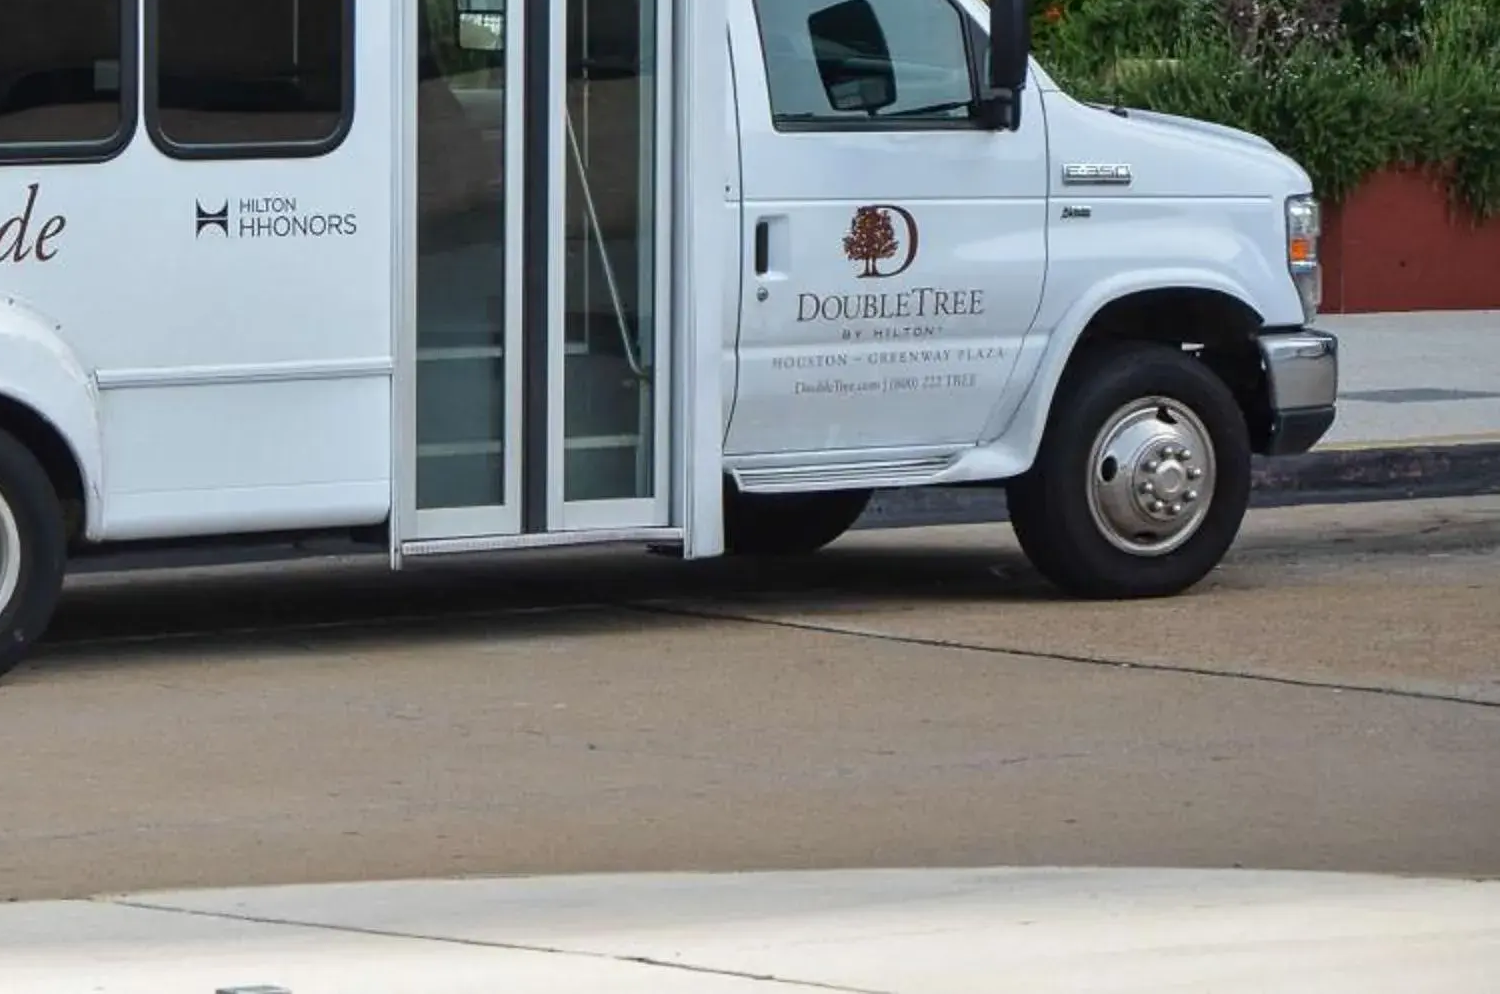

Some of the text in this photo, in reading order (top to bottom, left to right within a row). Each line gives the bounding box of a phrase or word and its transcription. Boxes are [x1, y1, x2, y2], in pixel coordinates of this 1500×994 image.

[239, 198, 297, 214] HILTON
[238, 213, 358, 238] HHONORS
[841, 326, 936, 341] BY HILTON
[771, 353, 848, 371] HOUSTON
[867, 349, 951, 366] GREENWAY
[957, 347, 1005, 363] PLAZA
